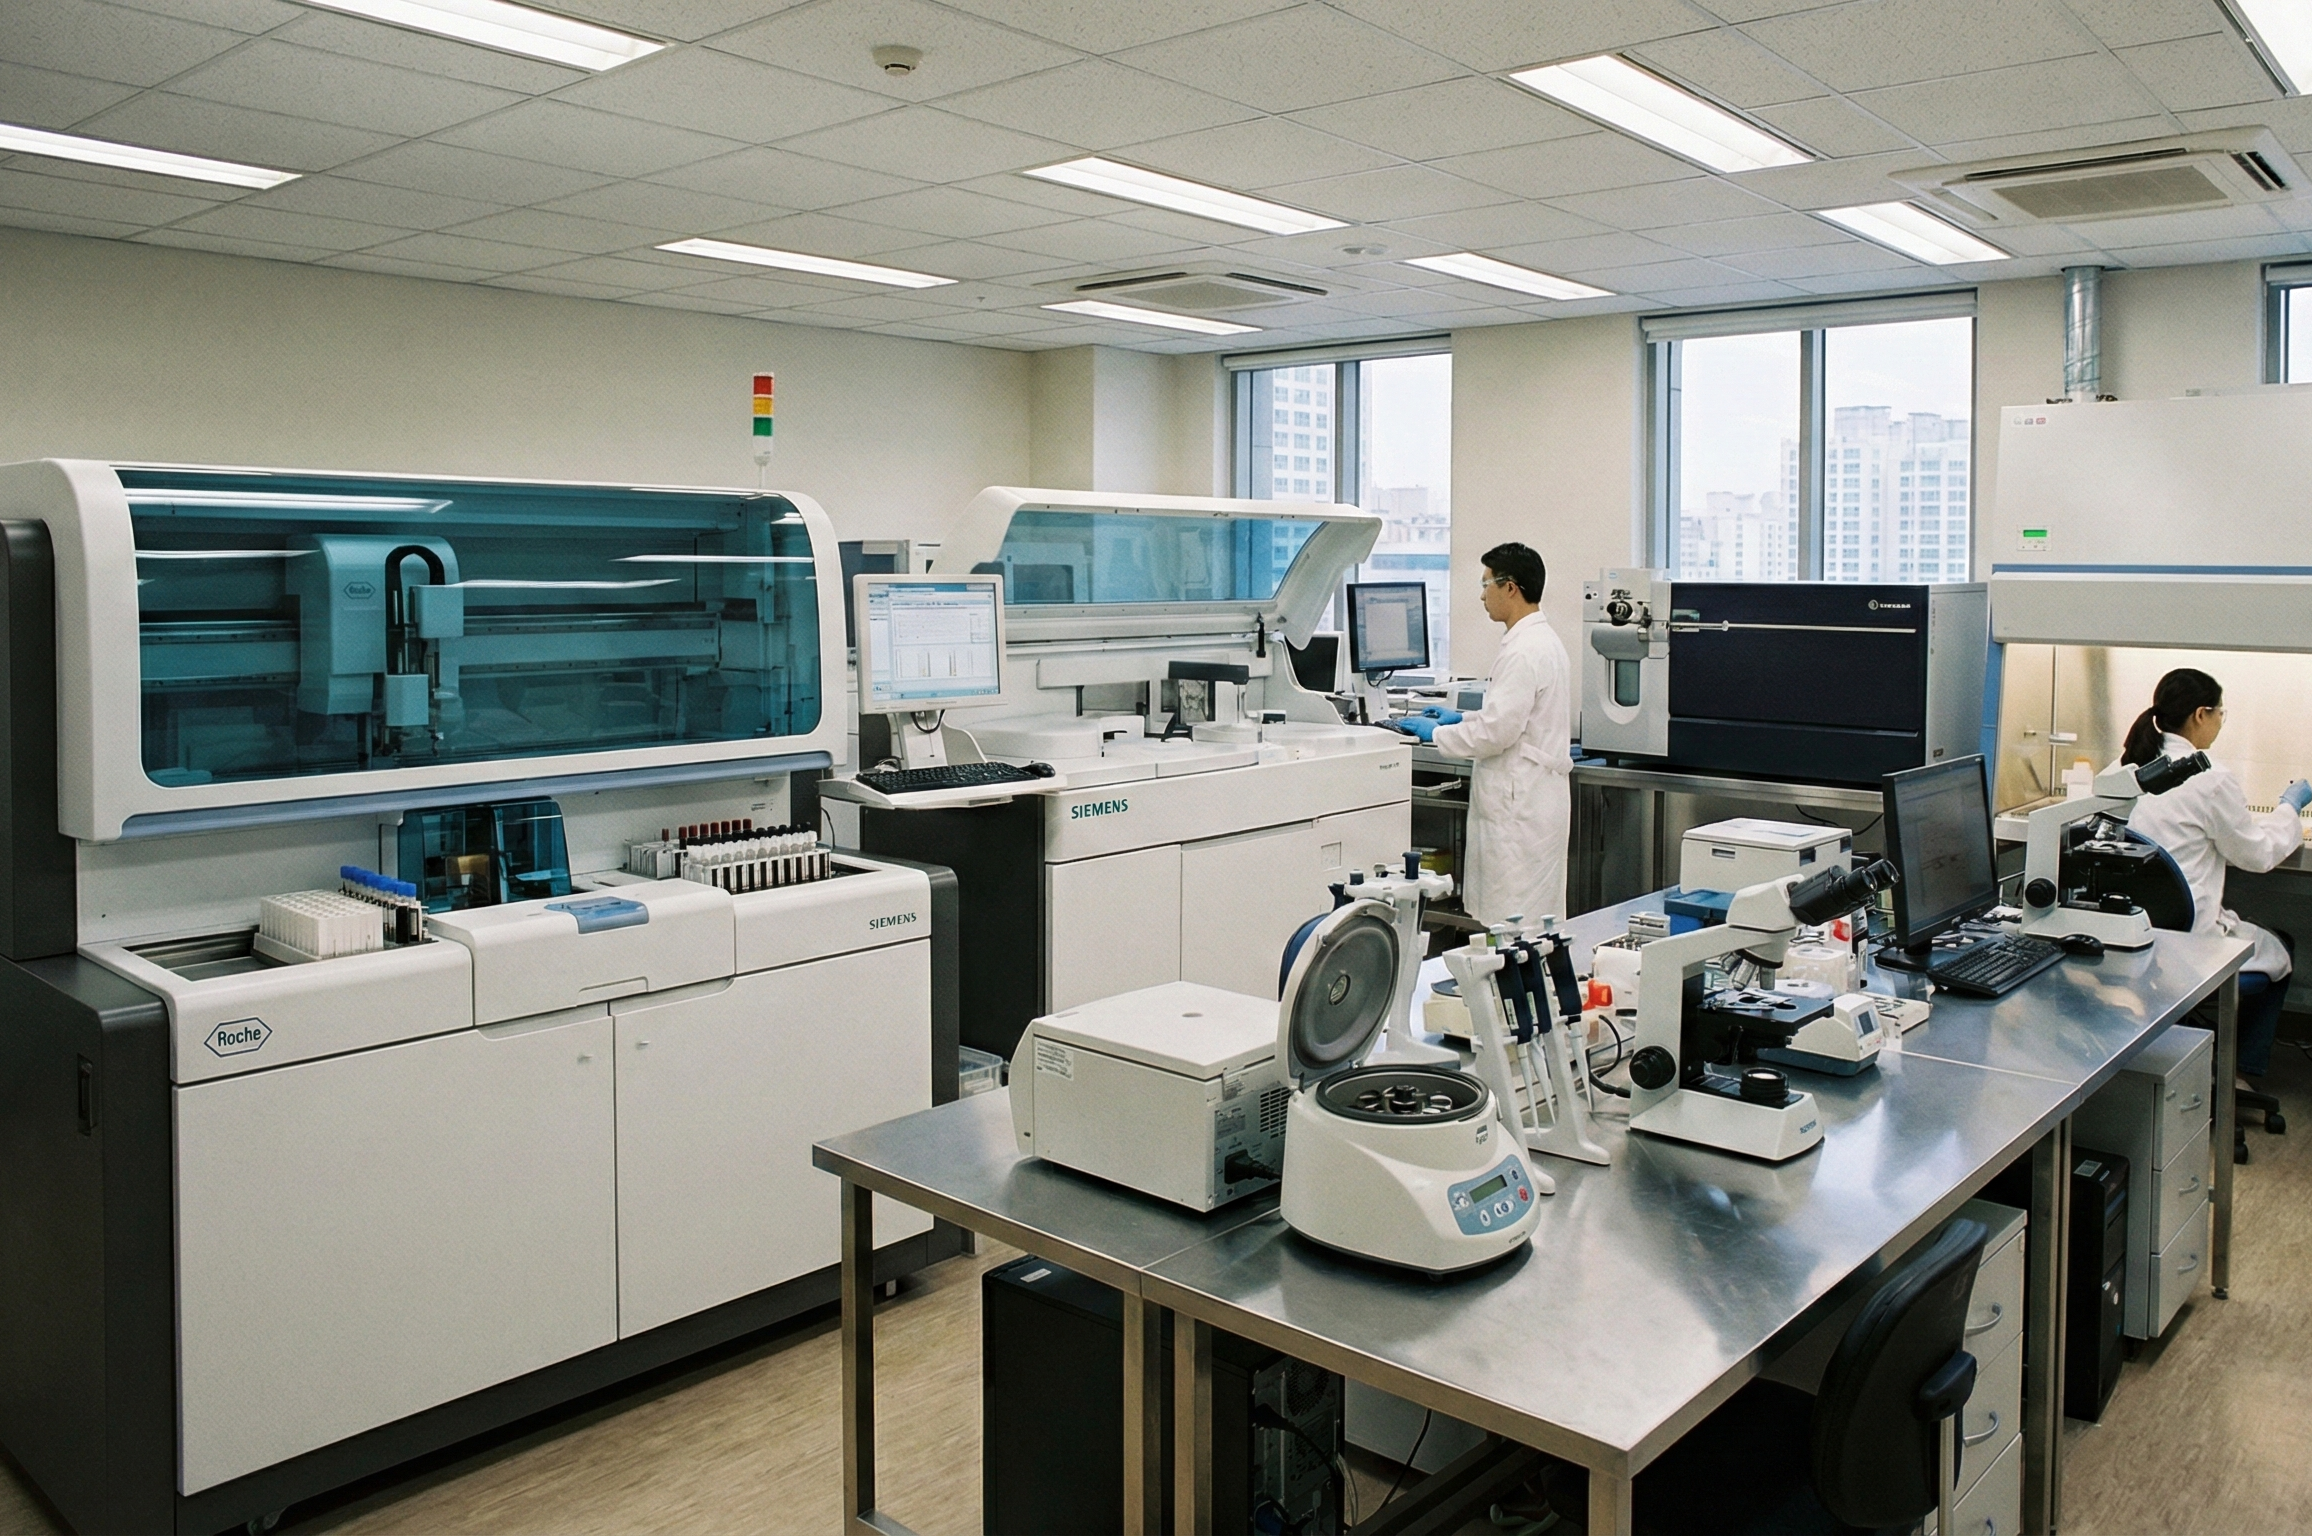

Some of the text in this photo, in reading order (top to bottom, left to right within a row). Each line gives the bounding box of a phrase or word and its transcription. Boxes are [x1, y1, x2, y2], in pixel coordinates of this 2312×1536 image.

[1071, 798, 1128, 819] SIEMENS
[869, 912, 917, 930] SIEMENS
[217, 1026, 261, 1047] Roche
